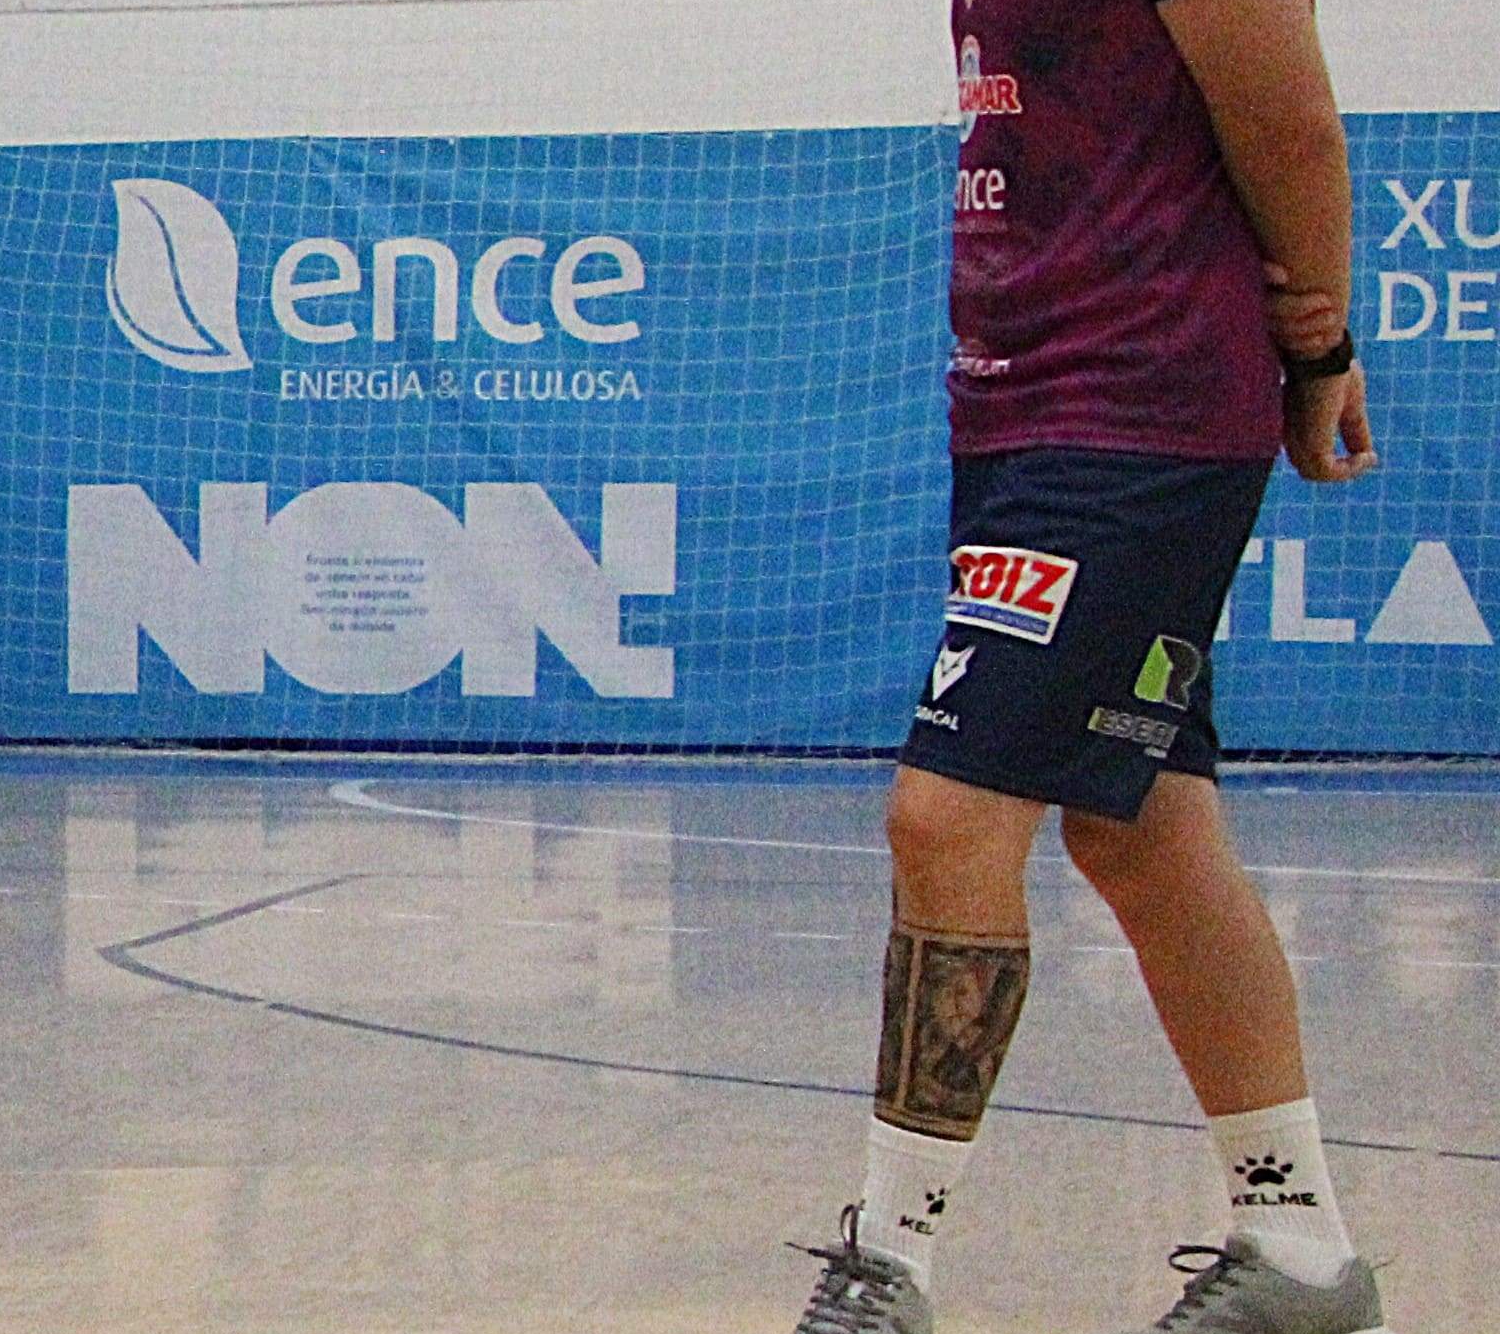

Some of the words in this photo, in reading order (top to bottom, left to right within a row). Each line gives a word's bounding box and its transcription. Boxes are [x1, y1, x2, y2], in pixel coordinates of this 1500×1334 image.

[954, 167, 1006, 211] nce
[270, 236, 646, 344] ence
[1377, 271, 1497, 341] DE
[280, 365, 423, 401] ENERGÍA
[435, 373, 462, 400] &
[473, 369, 642, 401] CELULOSA
[67, 482, 677, 698] NON
[1232, 1191, 1318, 1209] KELME
